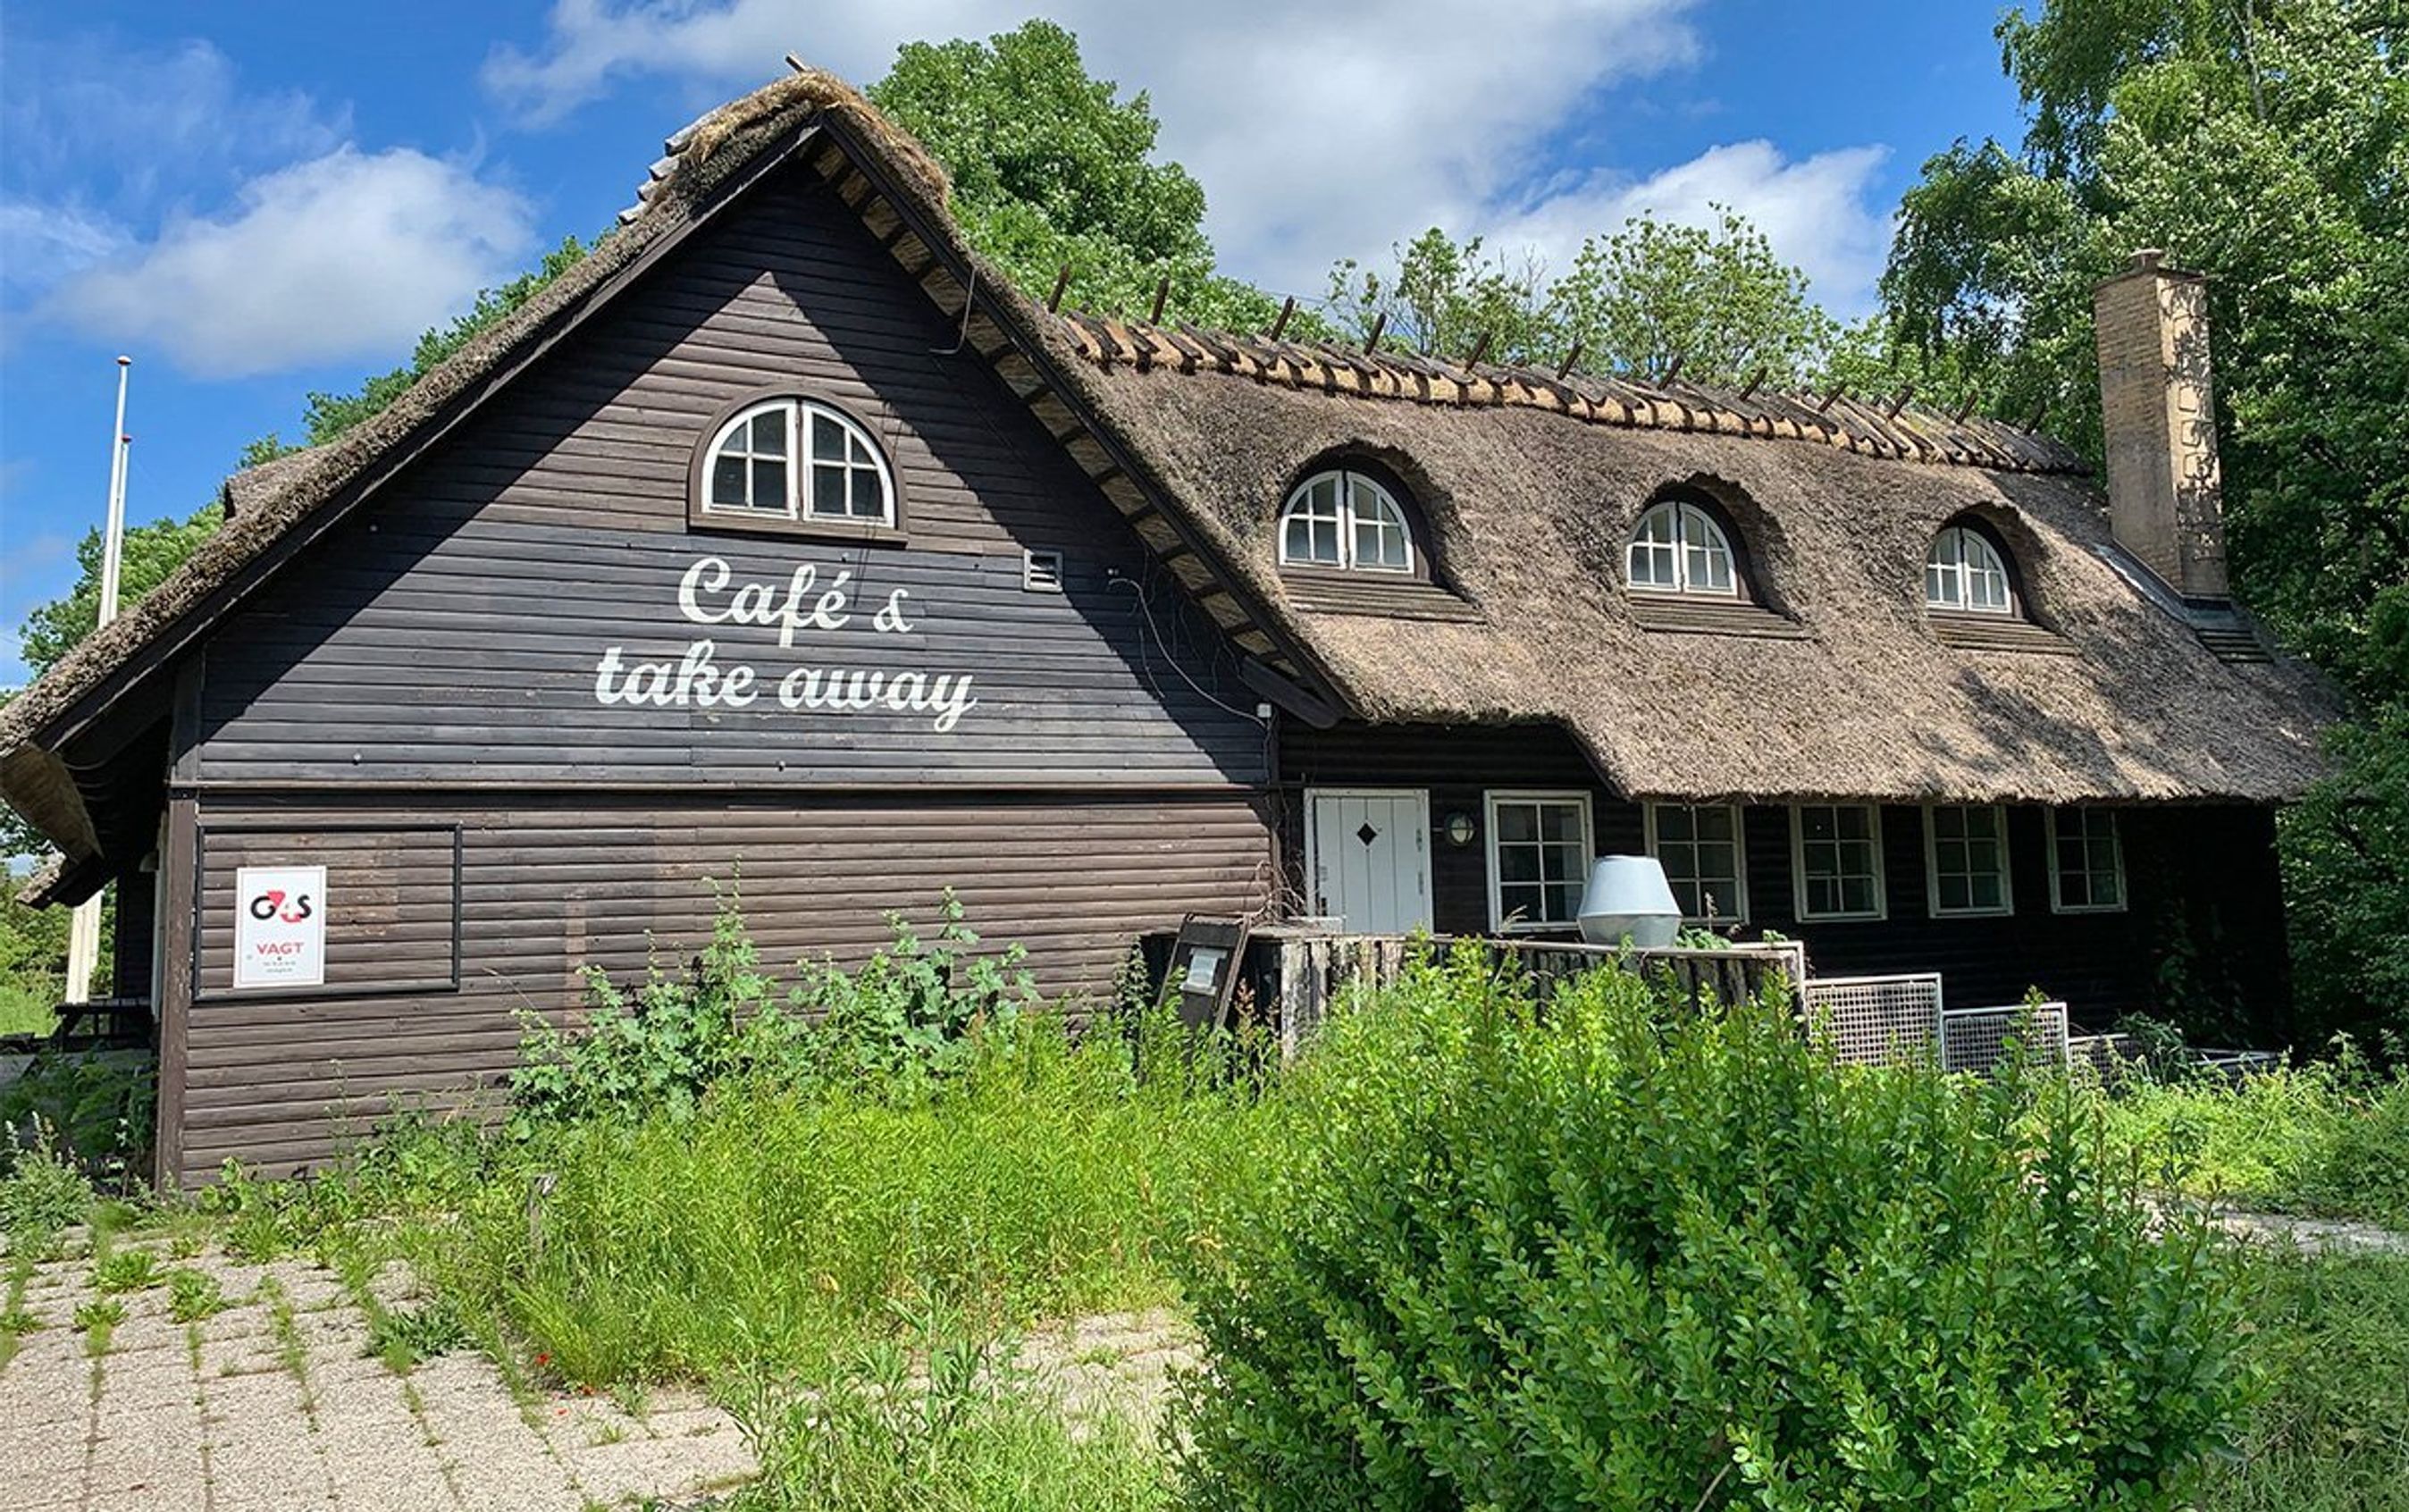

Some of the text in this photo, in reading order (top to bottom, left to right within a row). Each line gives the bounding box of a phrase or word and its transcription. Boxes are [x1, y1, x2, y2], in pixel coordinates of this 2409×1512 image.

[677, 557, 914, 648] Café &
[594, 639, 978, 732] take away
[256, 942, 305, 955] VAGT
